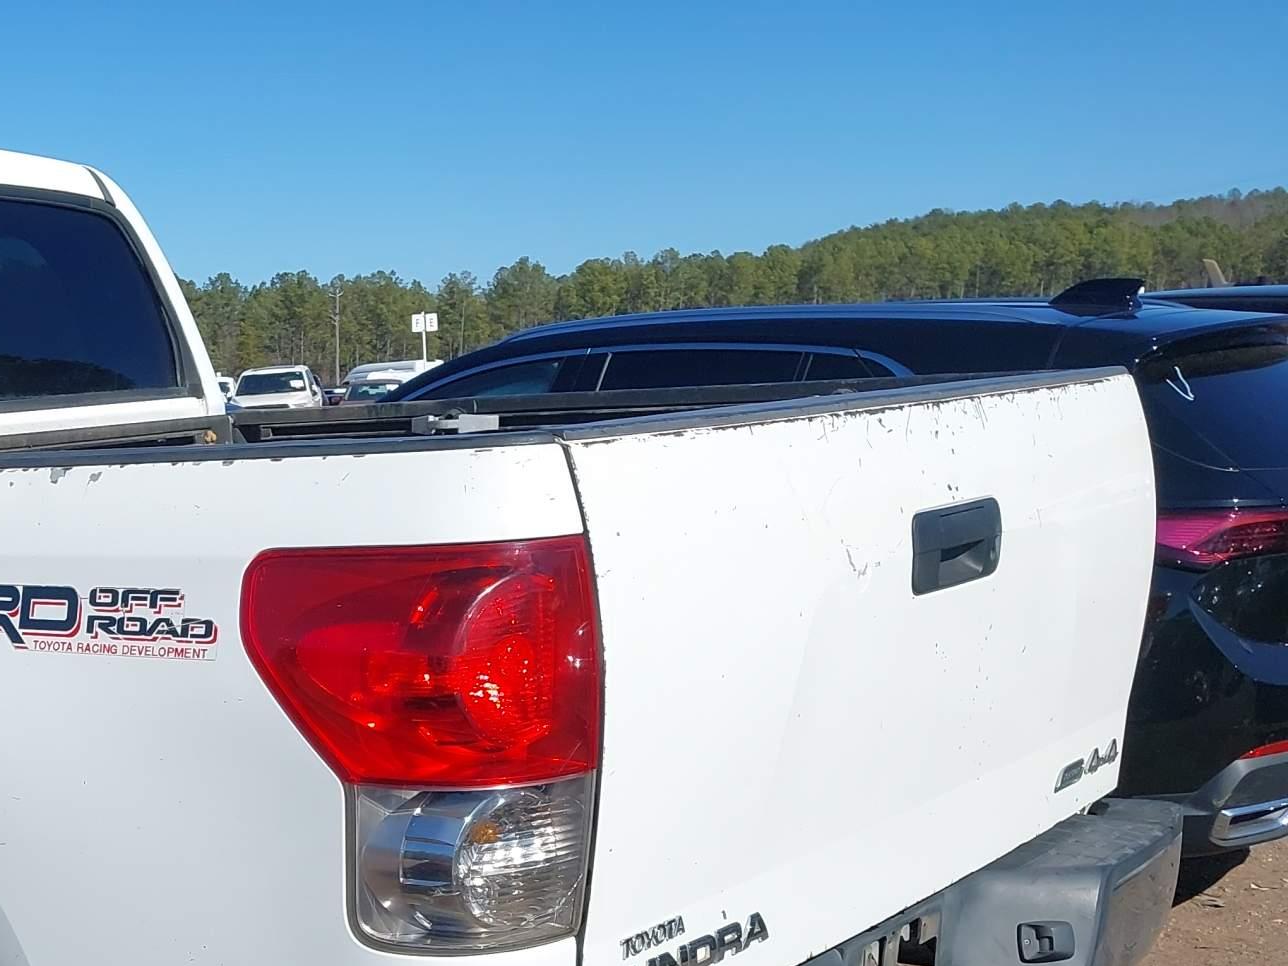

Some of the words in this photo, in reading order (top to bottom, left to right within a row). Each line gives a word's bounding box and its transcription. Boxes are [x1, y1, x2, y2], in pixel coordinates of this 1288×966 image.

[88, 586, 185, 613] OFF
[85, 614, 218, 644] ROAD
[32, 639, 73, 652] TOYOTA
[76, 642, 118, 655] RACING
[121, 644, 209, 659] DEVELOPMENT
[620, 915, 686, 960] TOYOTA
